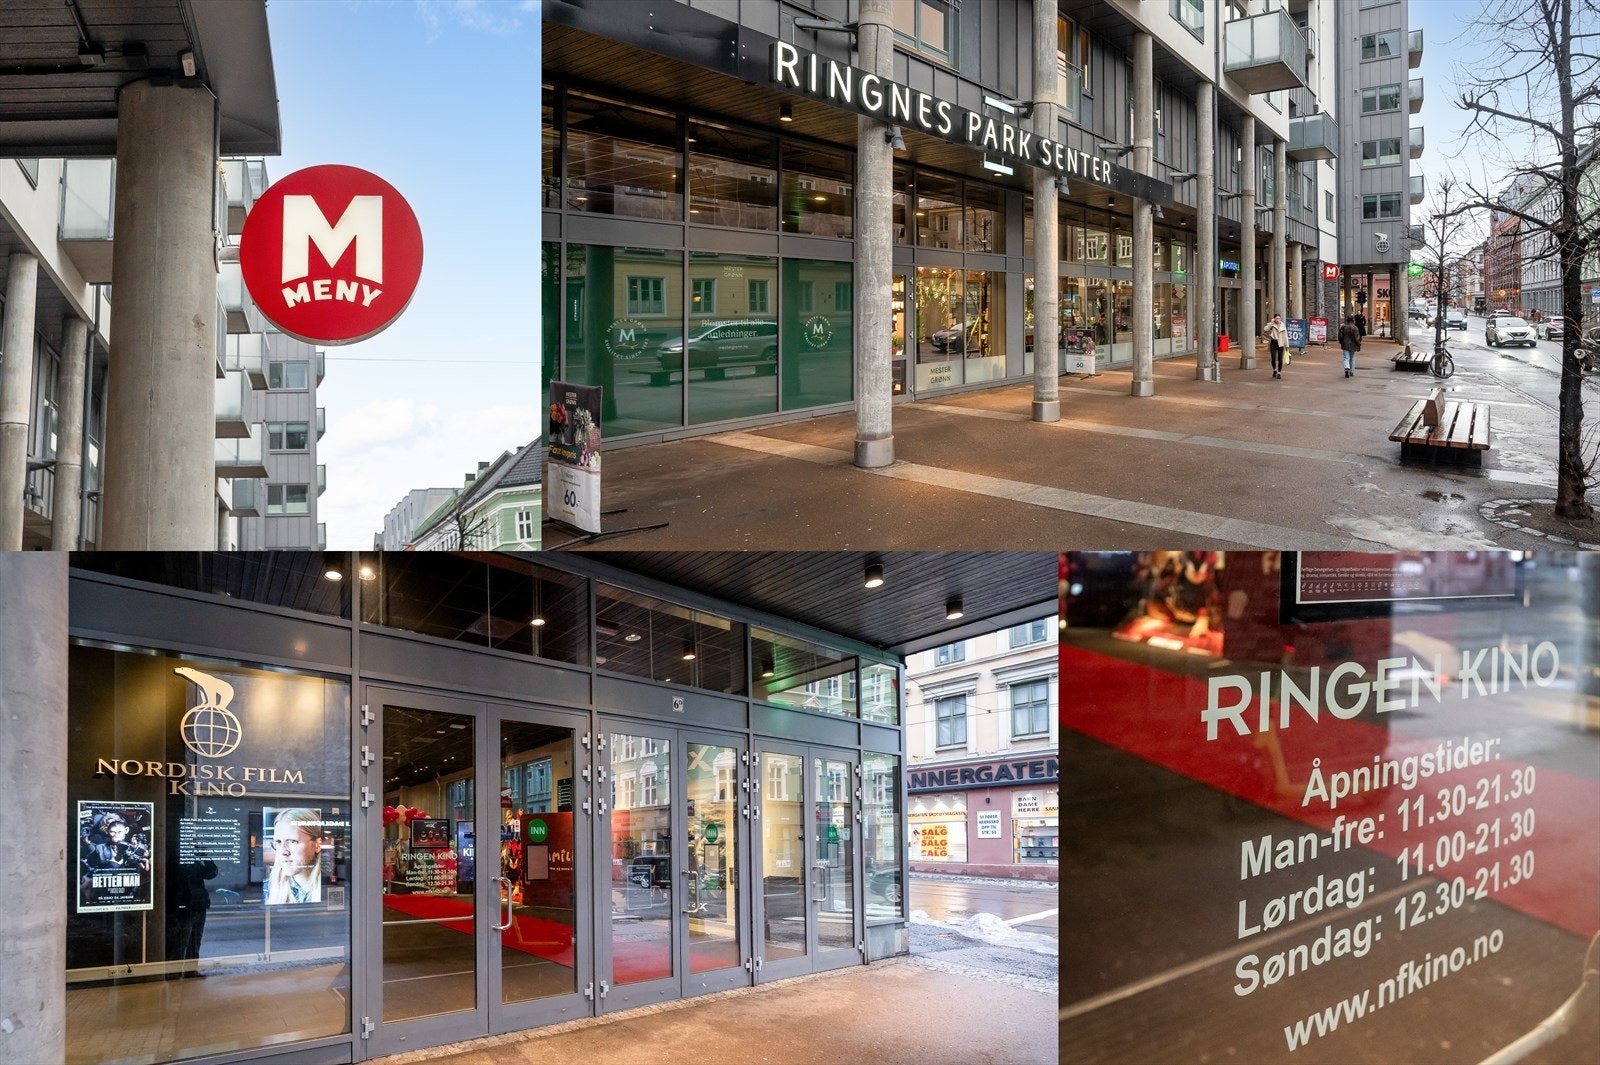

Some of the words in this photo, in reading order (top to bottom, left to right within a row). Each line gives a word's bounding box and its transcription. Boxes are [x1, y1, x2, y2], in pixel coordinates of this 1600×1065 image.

[776, 40, 951, 134] RINGNES
[967, 111, 1030, 160] PARK
[1041, 138, 1112, 185] SENTER
[281, 195, 383, 285] M
[281, 279, 383, 308] MENY
[1376, 288, 1390, 299] SK
[619, 328, 636, 342] M
[707, 330, 759, 339] anledninger.
[812, 323, 824, 335] M
[930, 366, 951, 374] MESTER
[1200, 653, 1442, 741] RINGEN
[1458, 640, 1560, 700] KINO
[95, 758, 235, 781] NORDISK
[242, 767, 306, 784] FILM
[907, 759, 1059, 789] NNERGATEN
[1301, 735, 1501, 808] Åpningstider:
[169, 779, 247, 798] KINO
[530, 826, 545, 835] INN
[1240, 813, 1385, 880] Man-fre:
[1397, 765, 1536, 832] 11.30-21.30
[921, 839, 948, 847] SALG
[401, 852, 435, 861] RINGEN
[437, 852, 458, 860] KINO
[92, 875, 123, 888] BETTER
[123, 875, 141, 887] MAN
[1236, 866, 1376, 939] Lørdag:
[1396, 808, 1535, 881] 11.00-21.30
[1233, 914, 1383, 997] Søndag:
[1394, 849, 1536, 931] 12.30-21.30
[1283, 928, 1504, 1053] www.nfkino.no
